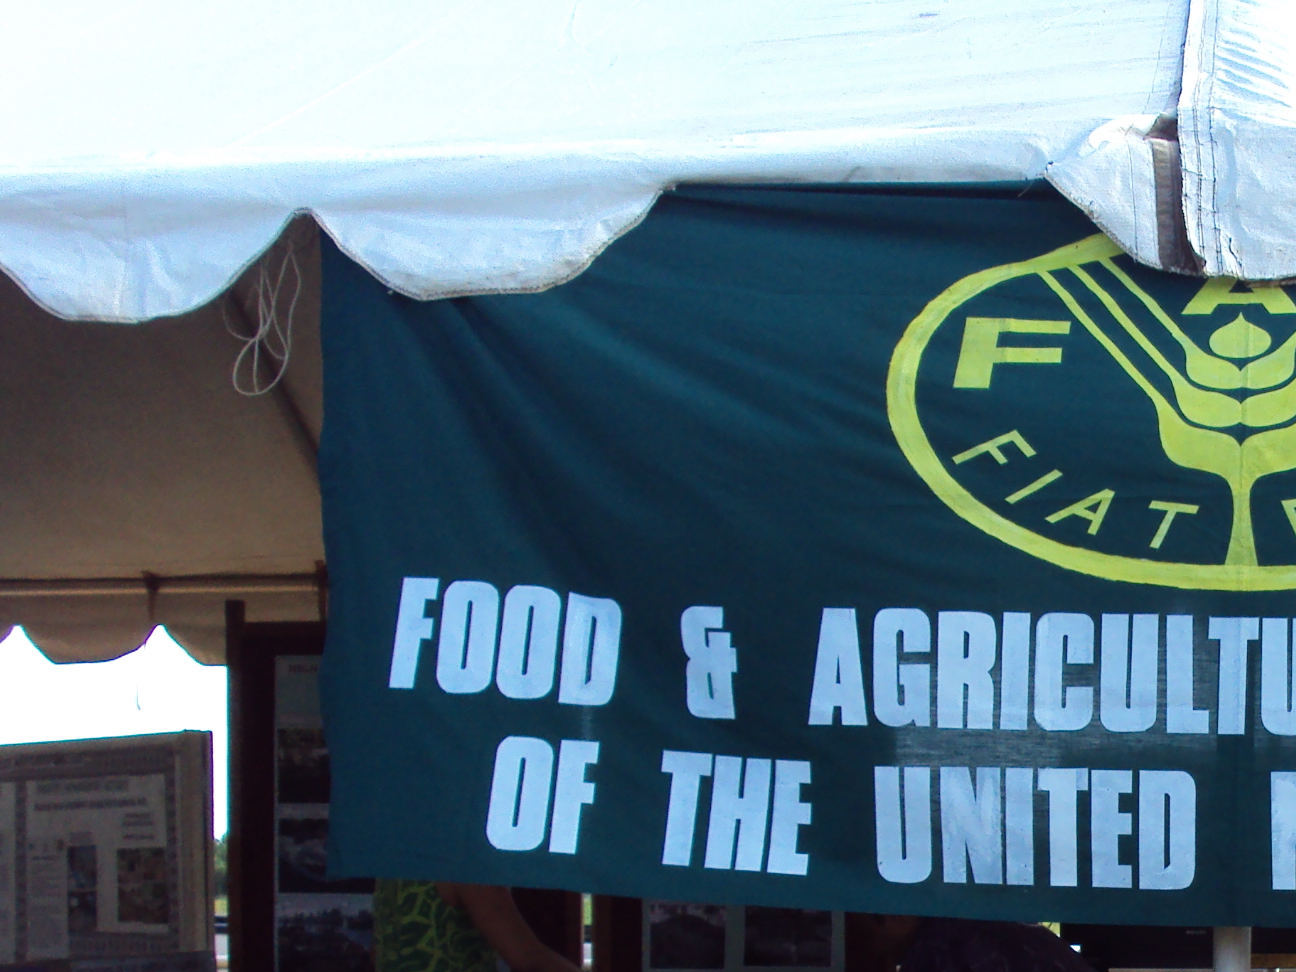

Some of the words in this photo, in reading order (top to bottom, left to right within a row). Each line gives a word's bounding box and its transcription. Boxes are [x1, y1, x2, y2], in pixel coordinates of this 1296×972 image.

[953, 429, 1198, 550] FIAT
[388, 577, 622, 706] FOOD
[680, 605, 738, 720] &
[485, 736, 600, 855] OF
[661, 749, 812, 876] THE
[874, 766, 1197, 891] UNITED
